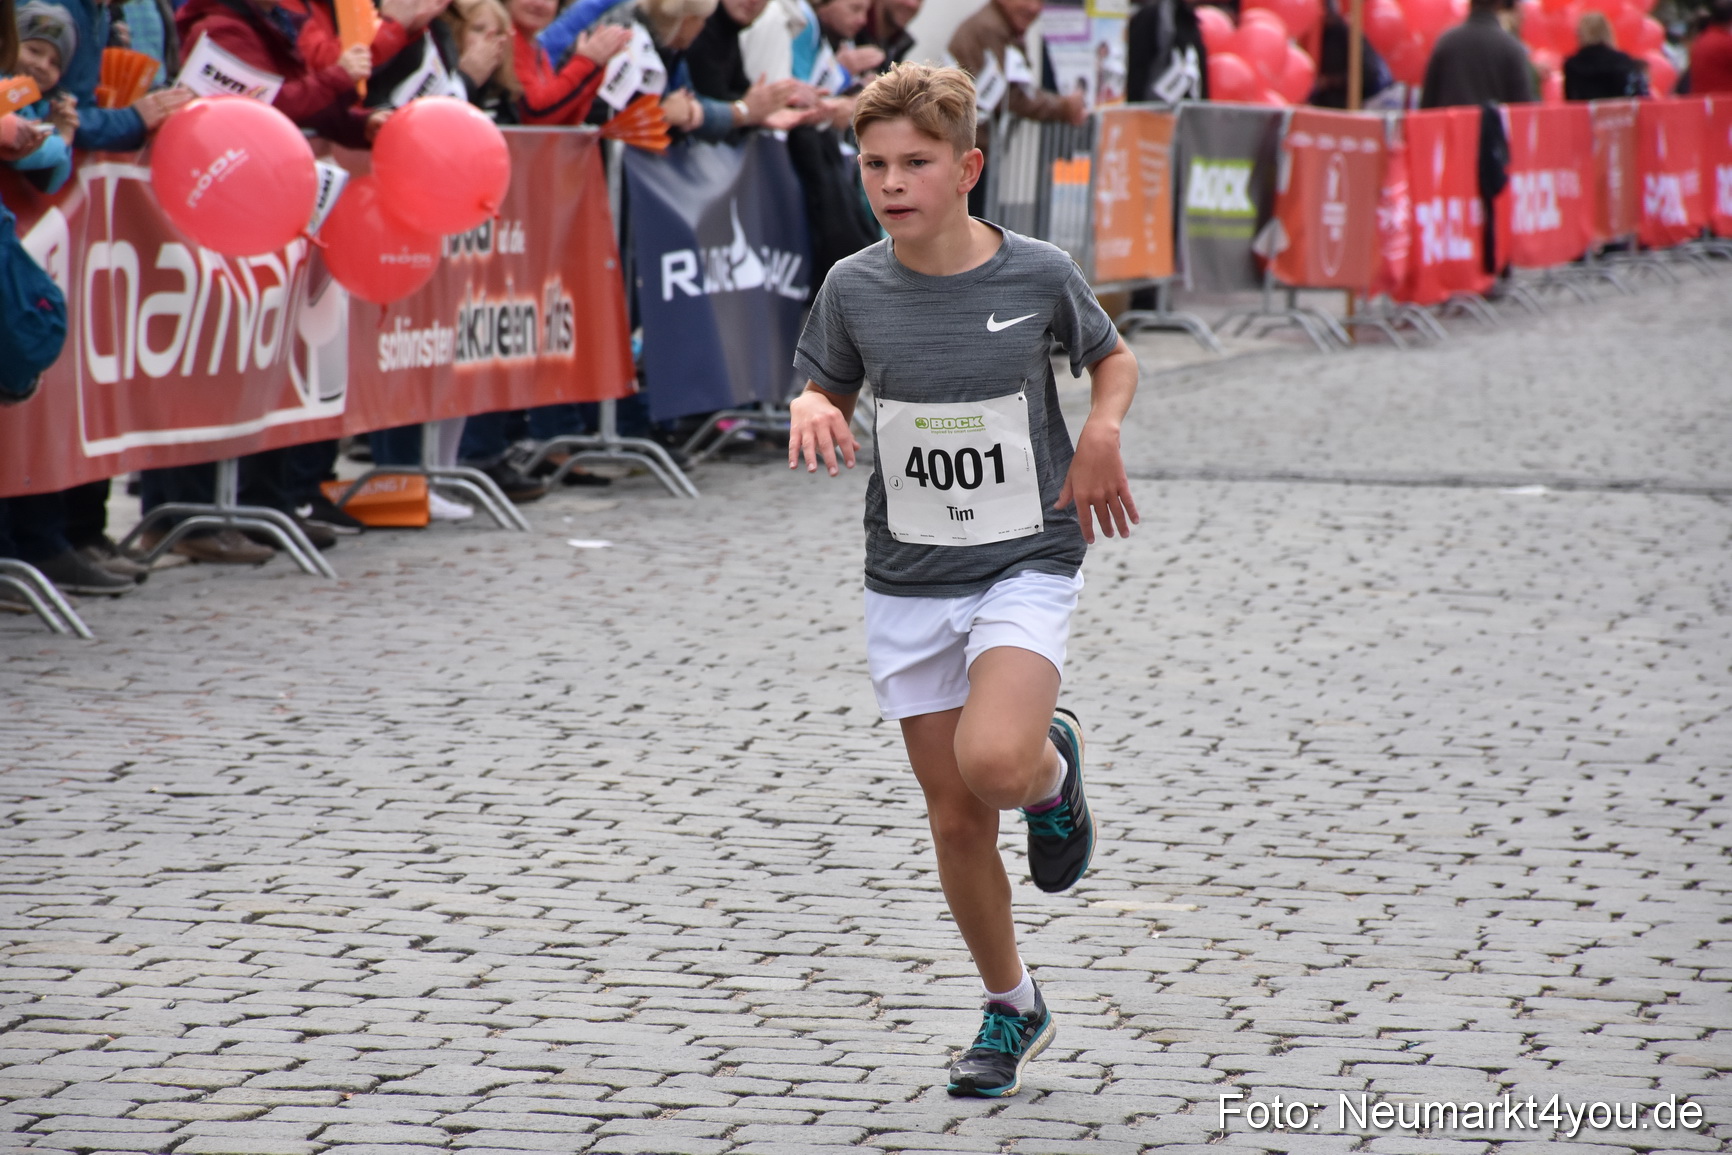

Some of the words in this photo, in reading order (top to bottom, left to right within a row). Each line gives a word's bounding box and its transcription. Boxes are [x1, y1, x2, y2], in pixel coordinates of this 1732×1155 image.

[203, 63, 248, 94] swn
[930, 415, 985, 429] BOCK
[905, 442, 1005, 491] 4001
[946, 505, 975, 521] Tim
